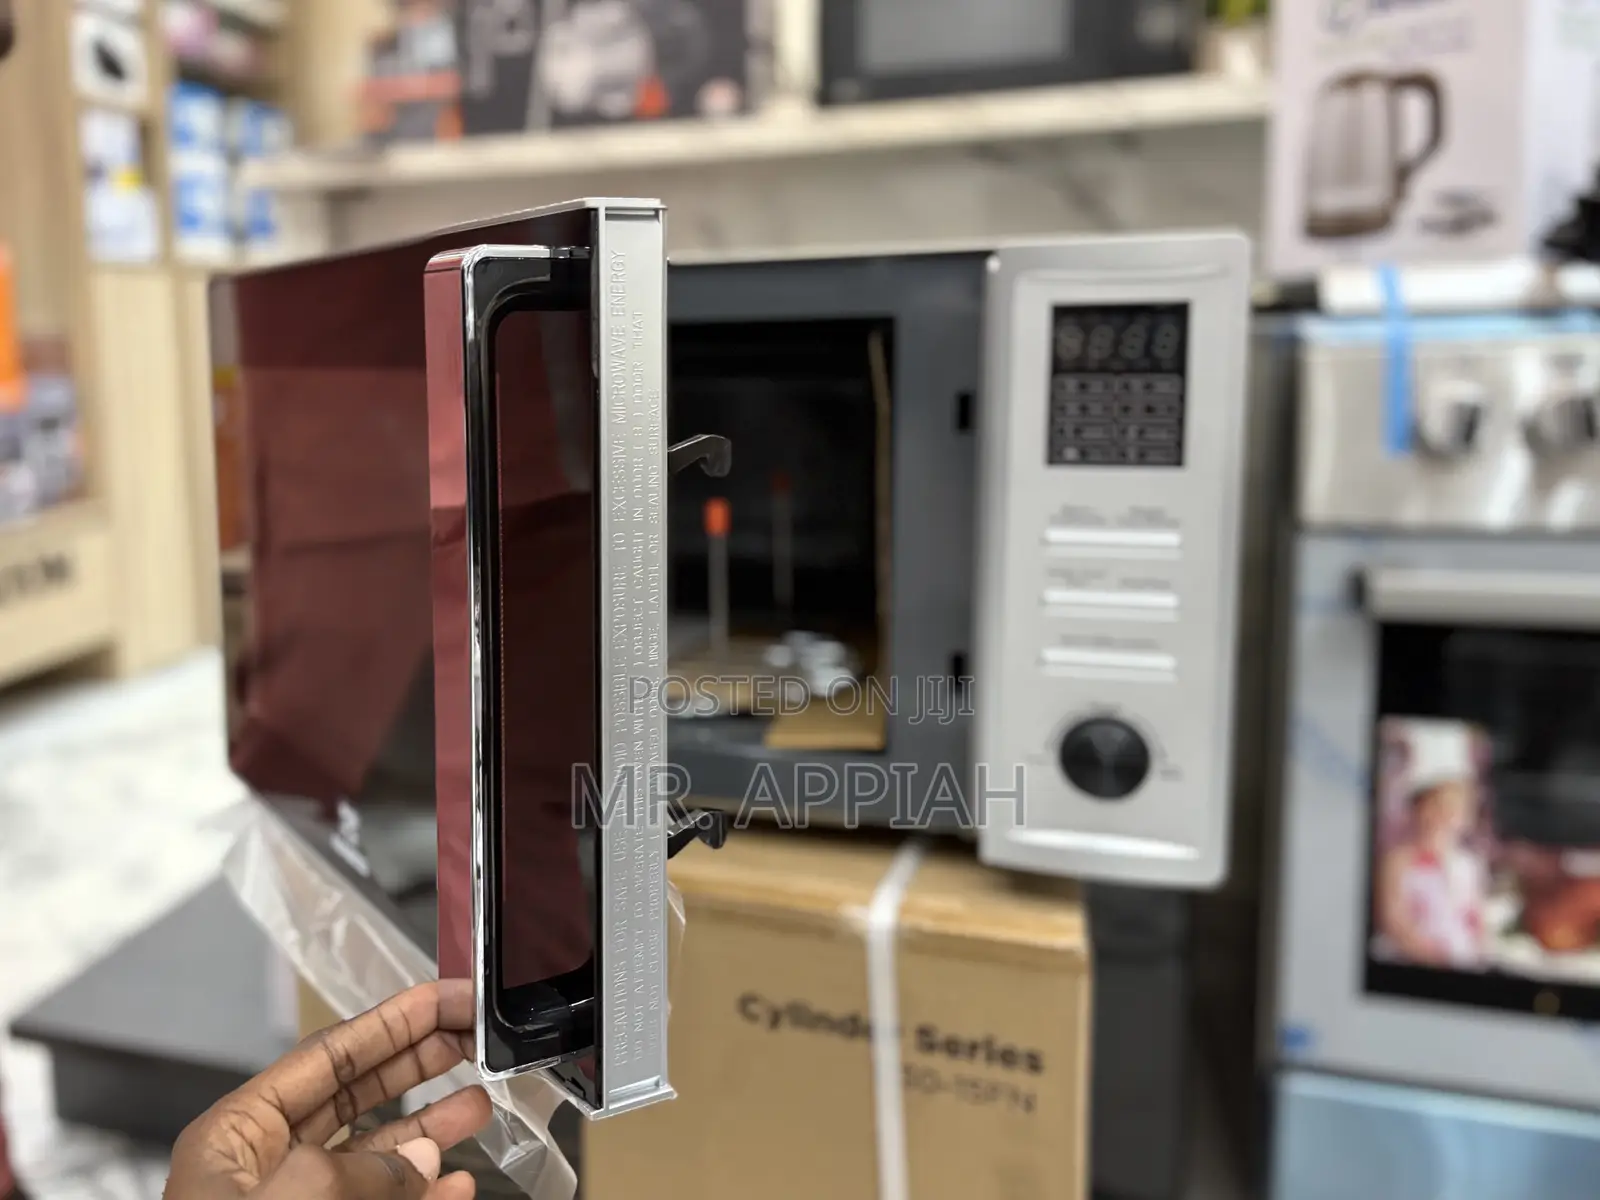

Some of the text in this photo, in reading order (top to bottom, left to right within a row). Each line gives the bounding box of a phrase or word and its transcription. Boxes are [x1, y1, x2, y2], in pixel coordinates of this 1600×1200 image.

[610, 248, 627, 317] ENERGY
[632, 311, 644, 351] THAT
[610, 326, 627, 424] MICROWAVE
[632, 360, 644, 403] DOOR
[611, 431, 627, 522] EXCESSIVE
[632, 457, 644, 498] DOOR
[648, 465, 660, 524] SEALING
[611, 531, 627, 551] TO
[632, 530, 644, 589] CAUGHT
[648, 532, 660, 556] OR
[611, 564, 627, 649] EXPOSURE
[632, 598, 644, 655] OBJECT
[611, 656, 628, 733] POSSIBLE
[611, 829, 628, 862] USE
[612, 869, 628, 913] SAFE
[633, 901, 644, 918] TO
[612, 919, 628, 953] FOR
[633, 1003, 644, 1032] NOT
[648, 984, 659, 1011] NOT
